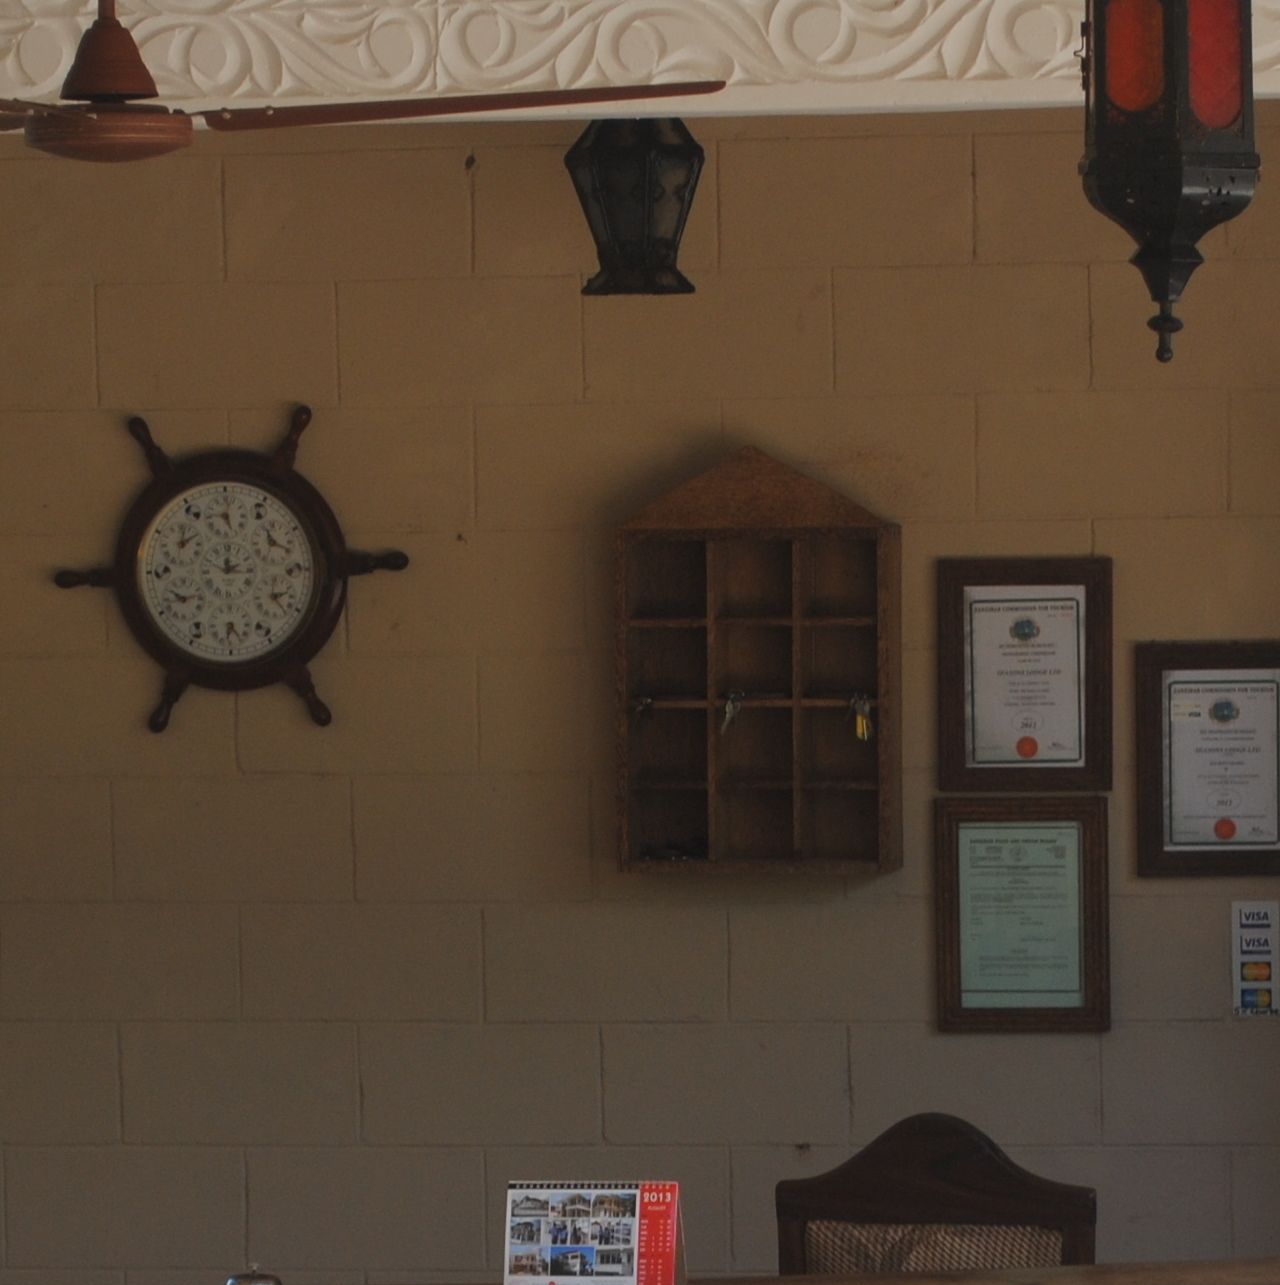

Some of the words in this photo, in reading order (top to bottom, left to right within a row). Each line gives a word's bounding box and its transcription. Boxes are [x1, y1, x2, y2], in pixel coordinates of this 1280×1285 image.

[1244, 911, 1269, 921] VISA
[1245, 938, 1270, 947] VISA
[643, 1192, 671, 1203] 2013
